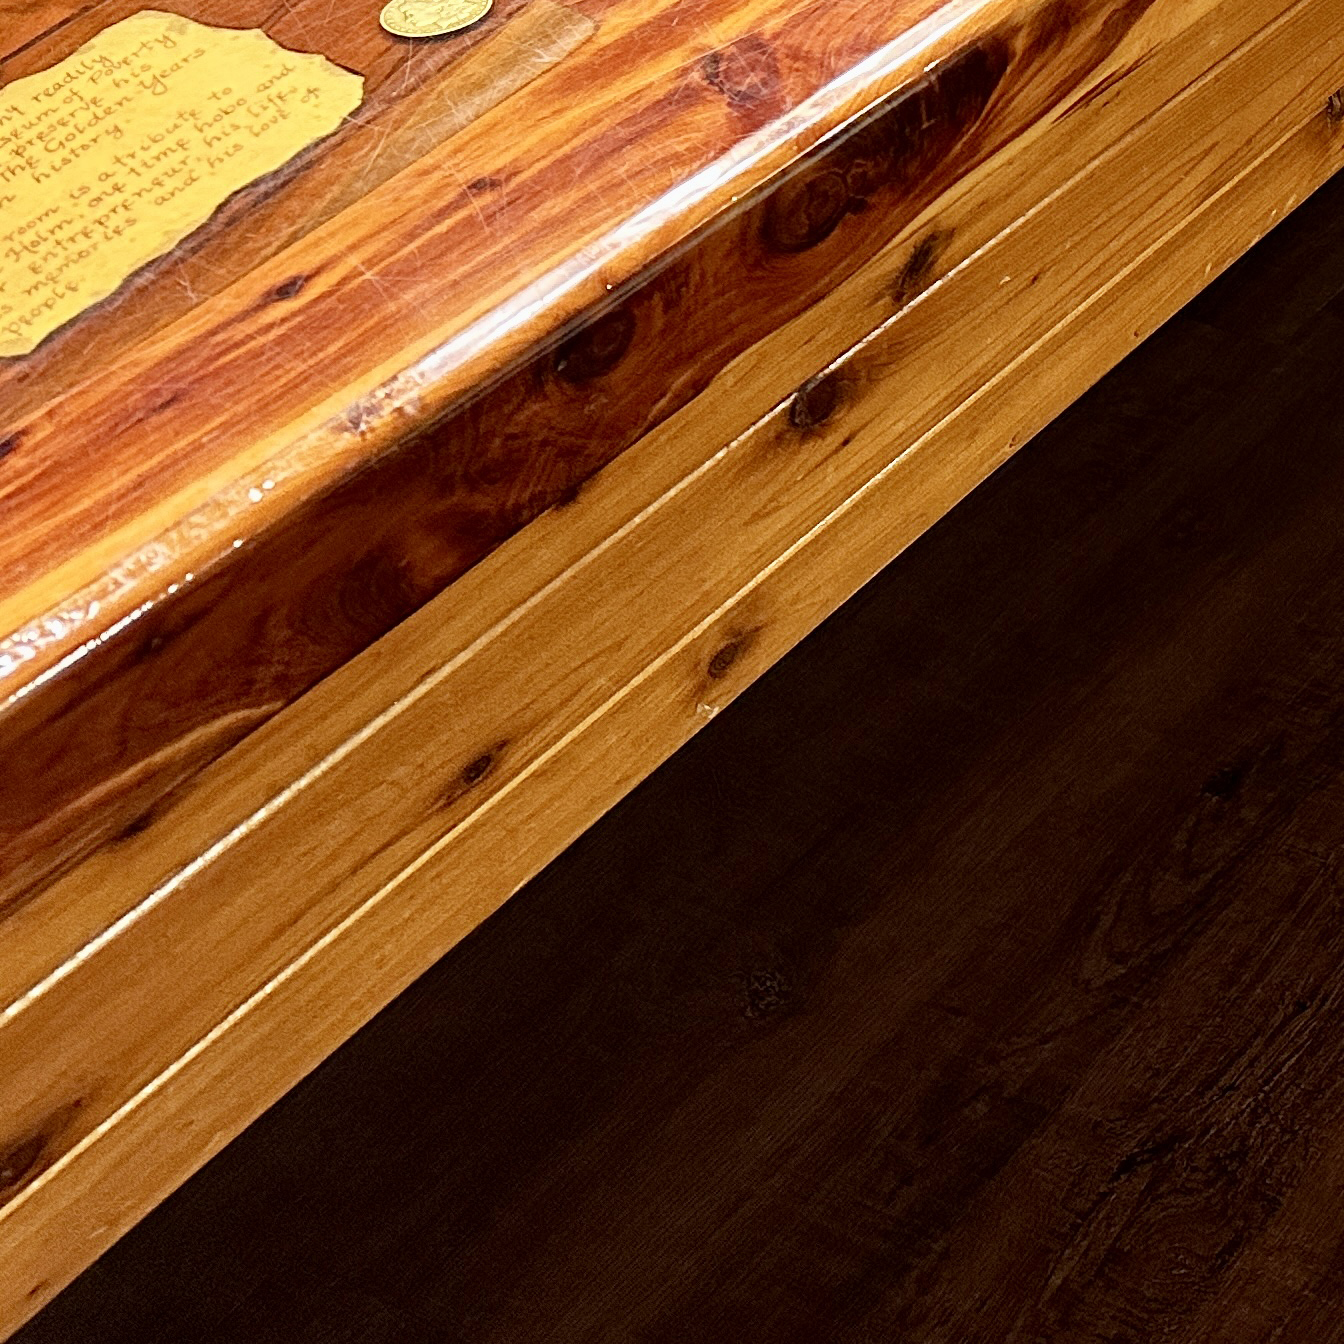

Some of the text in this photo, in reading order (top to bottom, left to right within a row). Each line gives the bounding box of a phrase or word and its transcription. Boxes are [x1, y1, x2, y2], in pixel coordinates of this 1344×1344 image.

[31, 55, 114, 103] readily
[62, 88, 84, 104] of
[193, 98, 248, 133] hobo
[256, 63, 296, 93] and
[8, 64, 151, 159] preserve his
[44, 96, 134, 153] Golden
[203, 124, 241, 148] his
[69, 185, 91, 200] is
[98, 171, 116, 183] a
[112, 109, 202, 167] tribute
[206, 87, 232, 100] to
[154, 169, 200, 206] and
[207, 143, 243, 169] his
